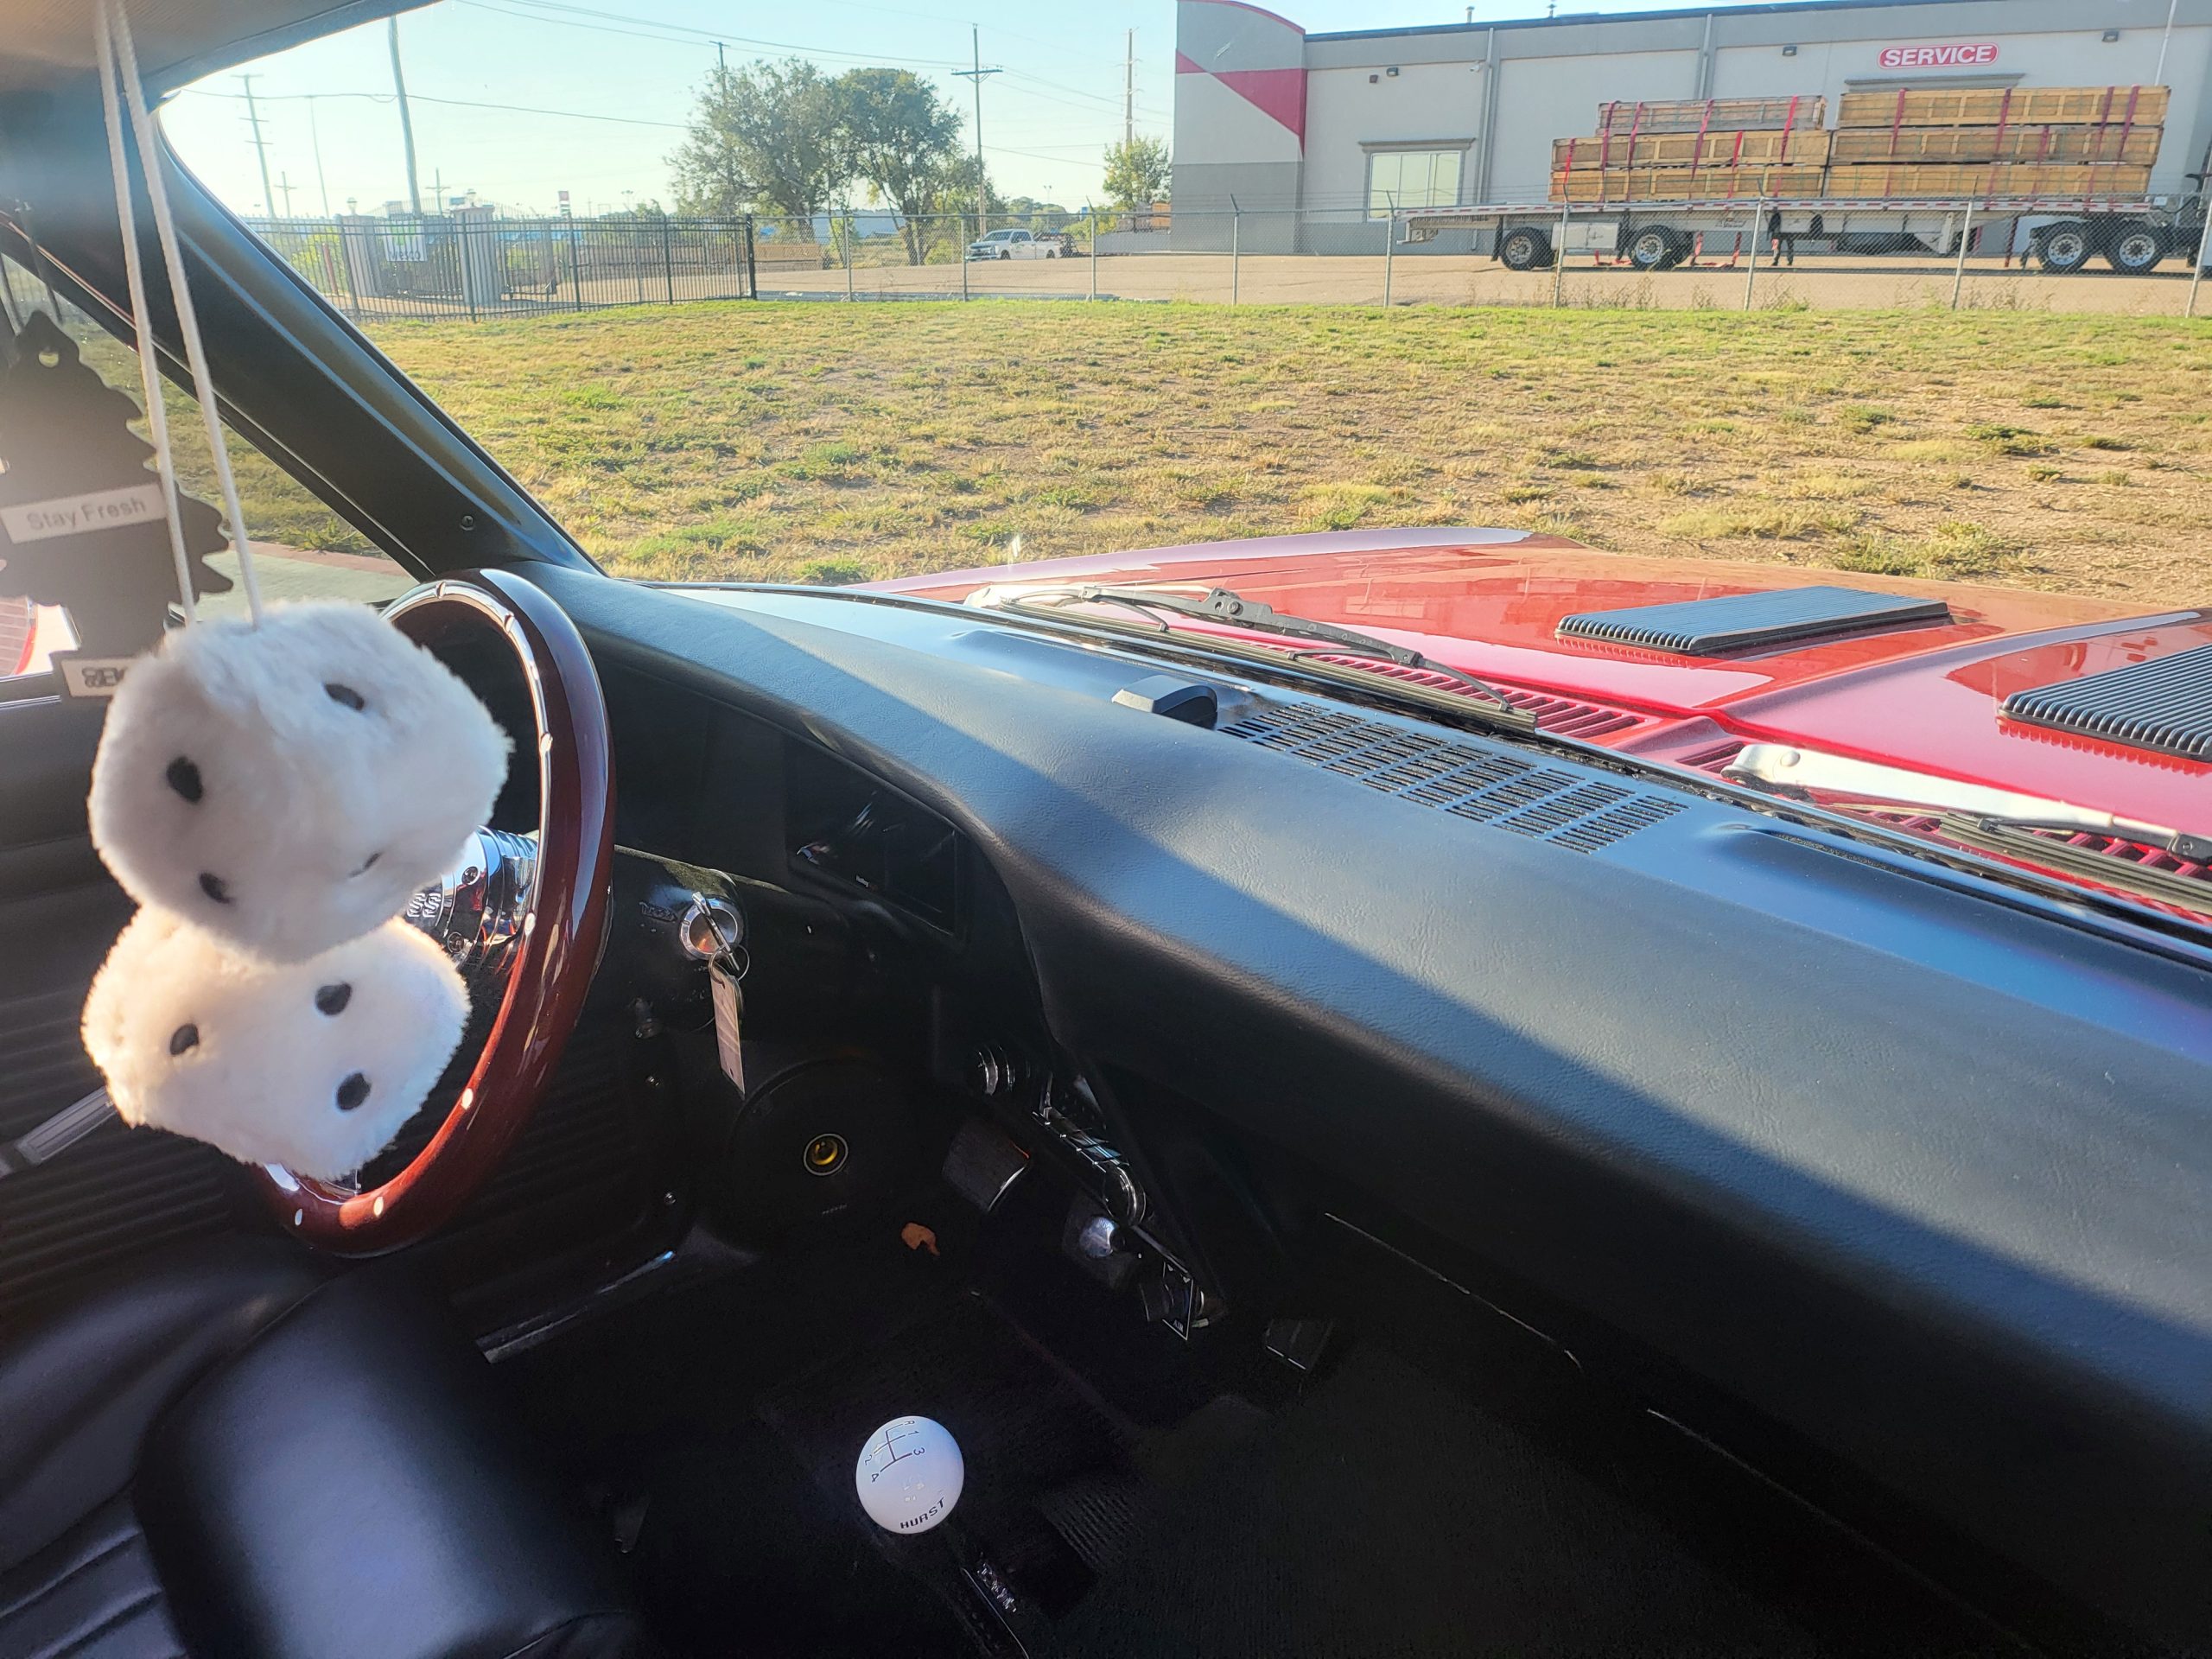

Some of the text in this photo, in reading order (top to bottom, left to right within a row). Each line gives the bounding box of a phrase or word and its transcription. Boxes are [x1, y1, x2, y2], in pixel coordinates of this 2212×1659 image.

[1884, 45, 1993, 67] SERVICE
[27, 498, 146, 531] Stay Fresh
[864, 1454, 873, 1465] 2
[912, 1447, 925, 1456] 3
[871, 1472, 880, 1483] 4
[899, 1497, 945, 1529] HURST
